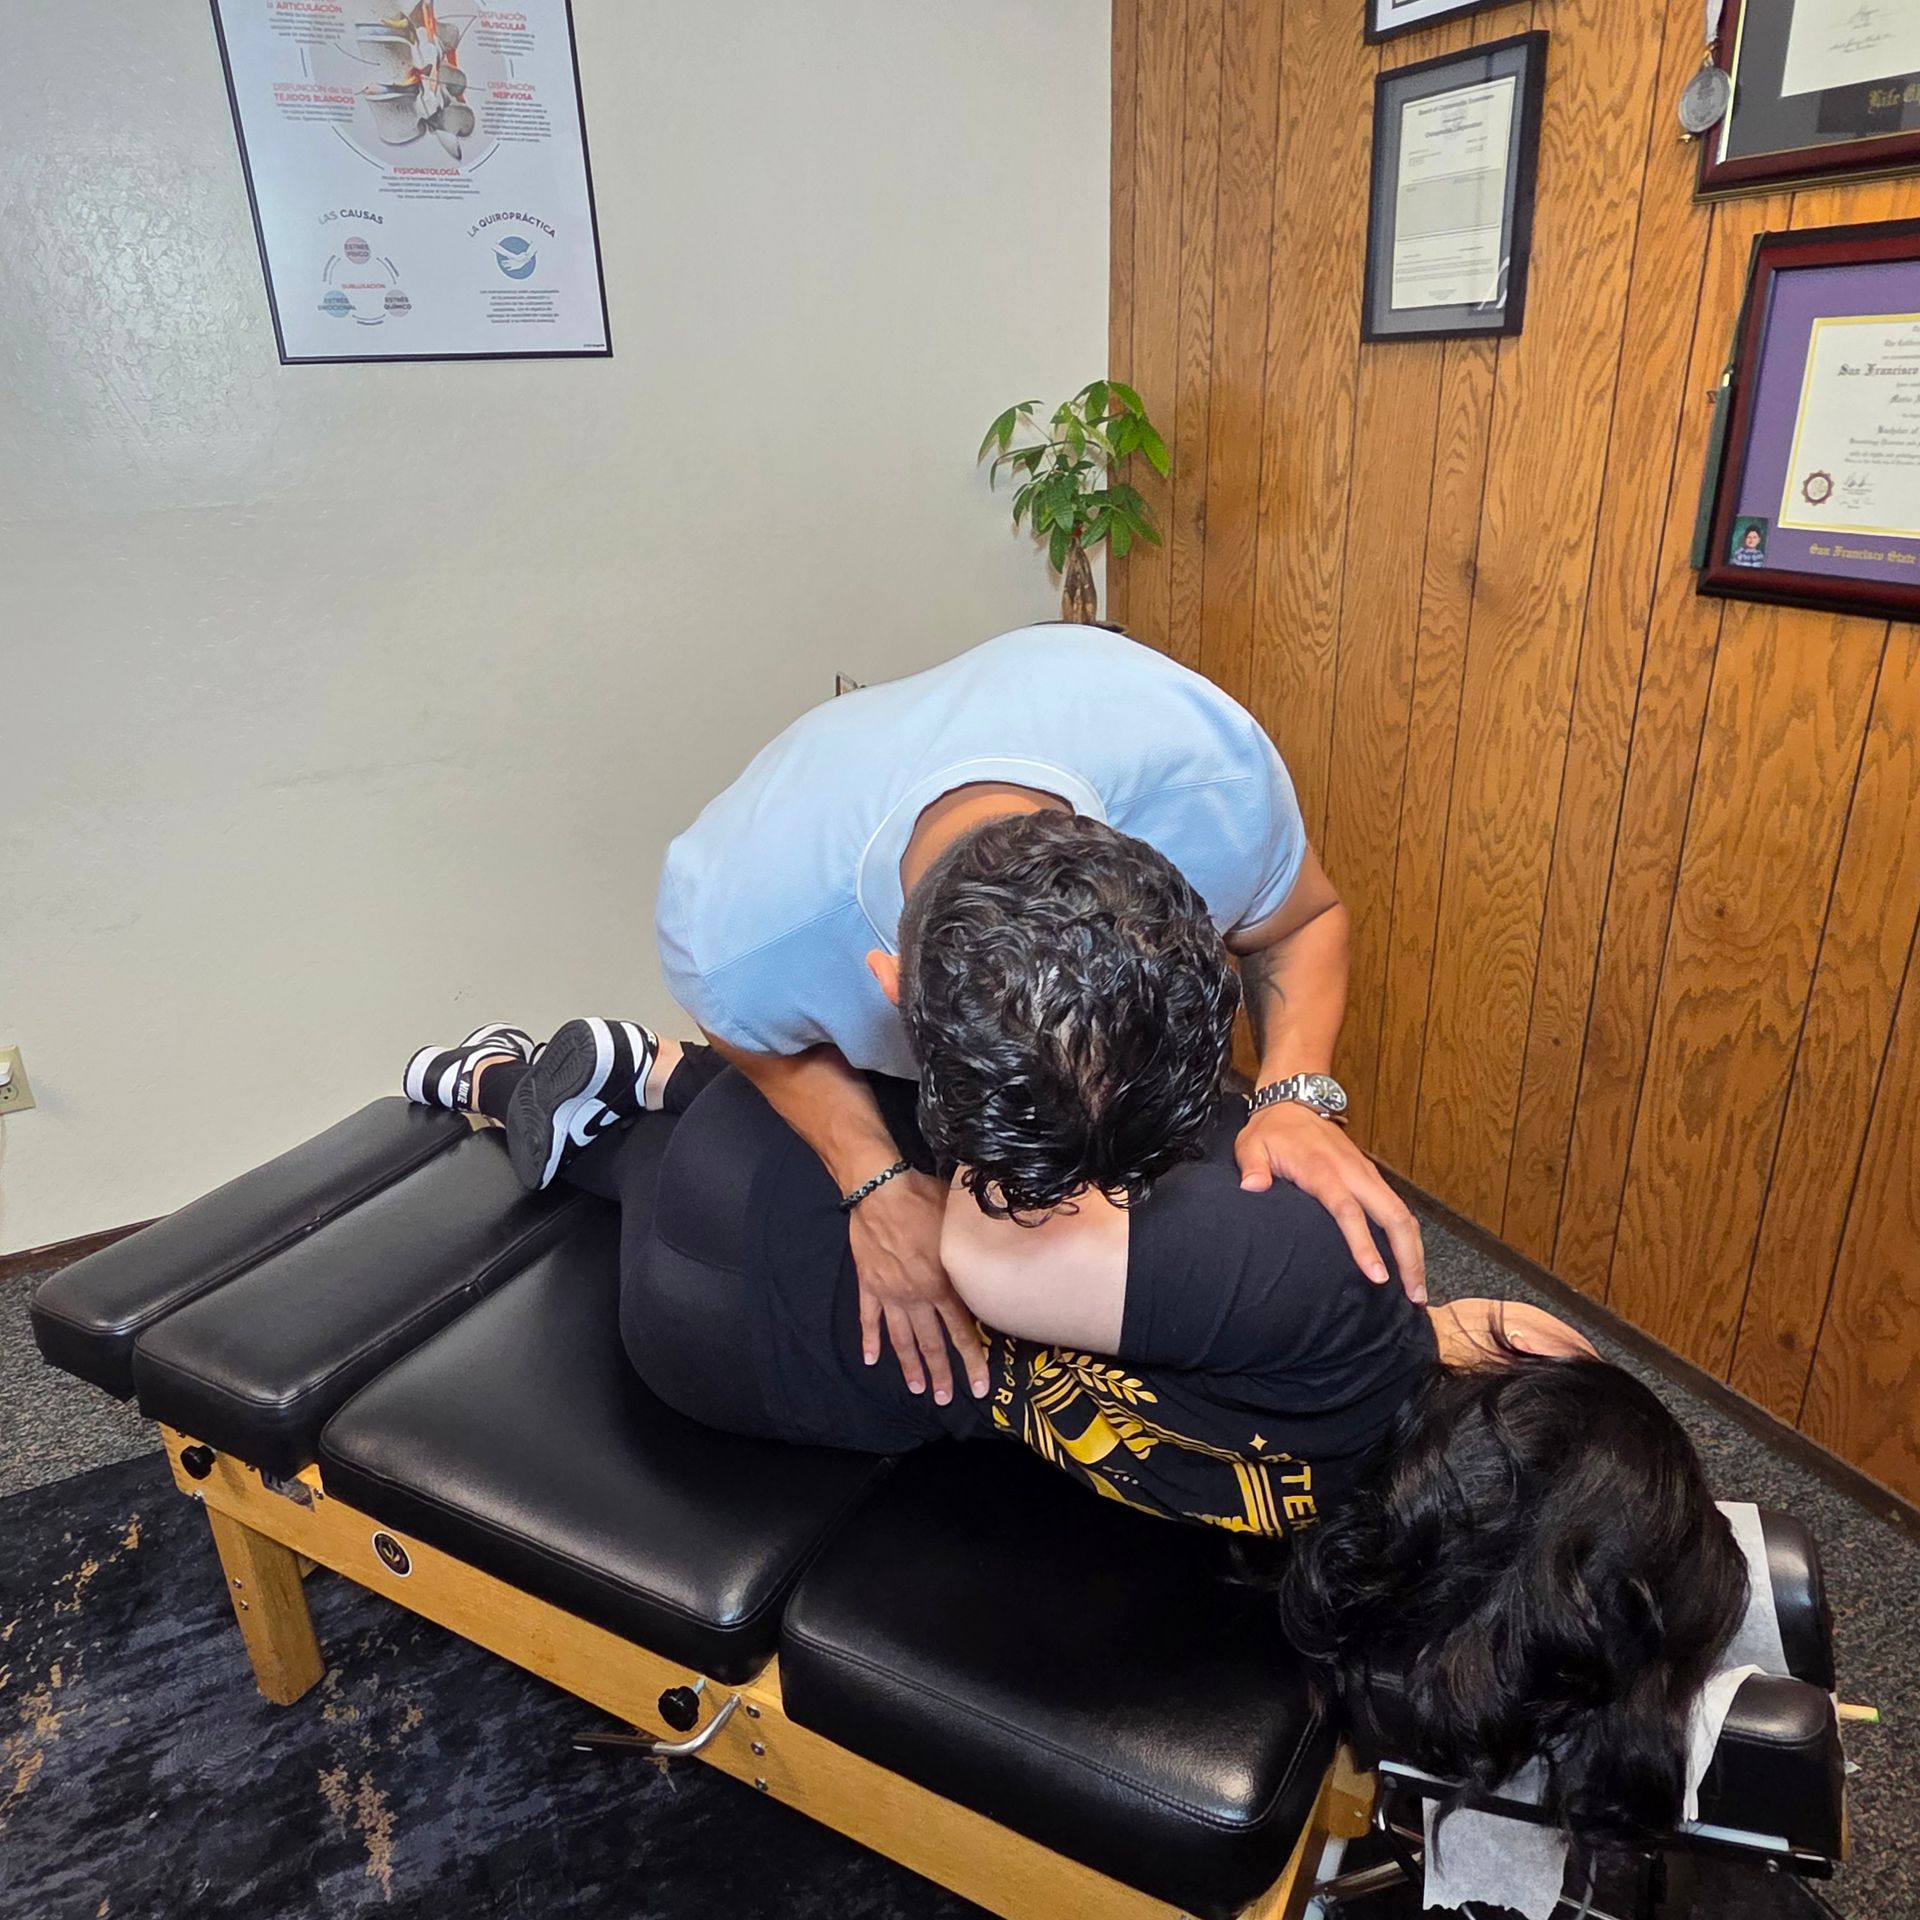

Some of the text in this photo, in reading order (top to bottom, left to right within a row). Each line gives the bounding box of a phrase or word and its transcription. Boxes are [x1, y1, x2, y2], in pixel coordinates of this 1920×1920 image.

[479, 10, 527, 21] DISFUNCIÓN
[481, 20, 526, 30] MUSCULAR
[273, 82, 326, 93] DISFUNCIÓN
[487, 81, 536, 92] DISFUNCIÓN
[274, 92, 356, 104] TEJIDOS BLANDOS
[492, 91, 533, 101] NERVIOSA
[393, 167, 460, 176] FISIOPATOLOGÍA
[318, 208, 384, 225] LAS CAUSAS
[467, 211, 556, 239] LA QUIROPRÁCTICA
[1838, 363, 1919, 376] San Francisco
[1809, 543, 1831, 556] San
[1833, 545, 1884, 561] Francisco
[457, 1079, 470, 1104] NIKE
